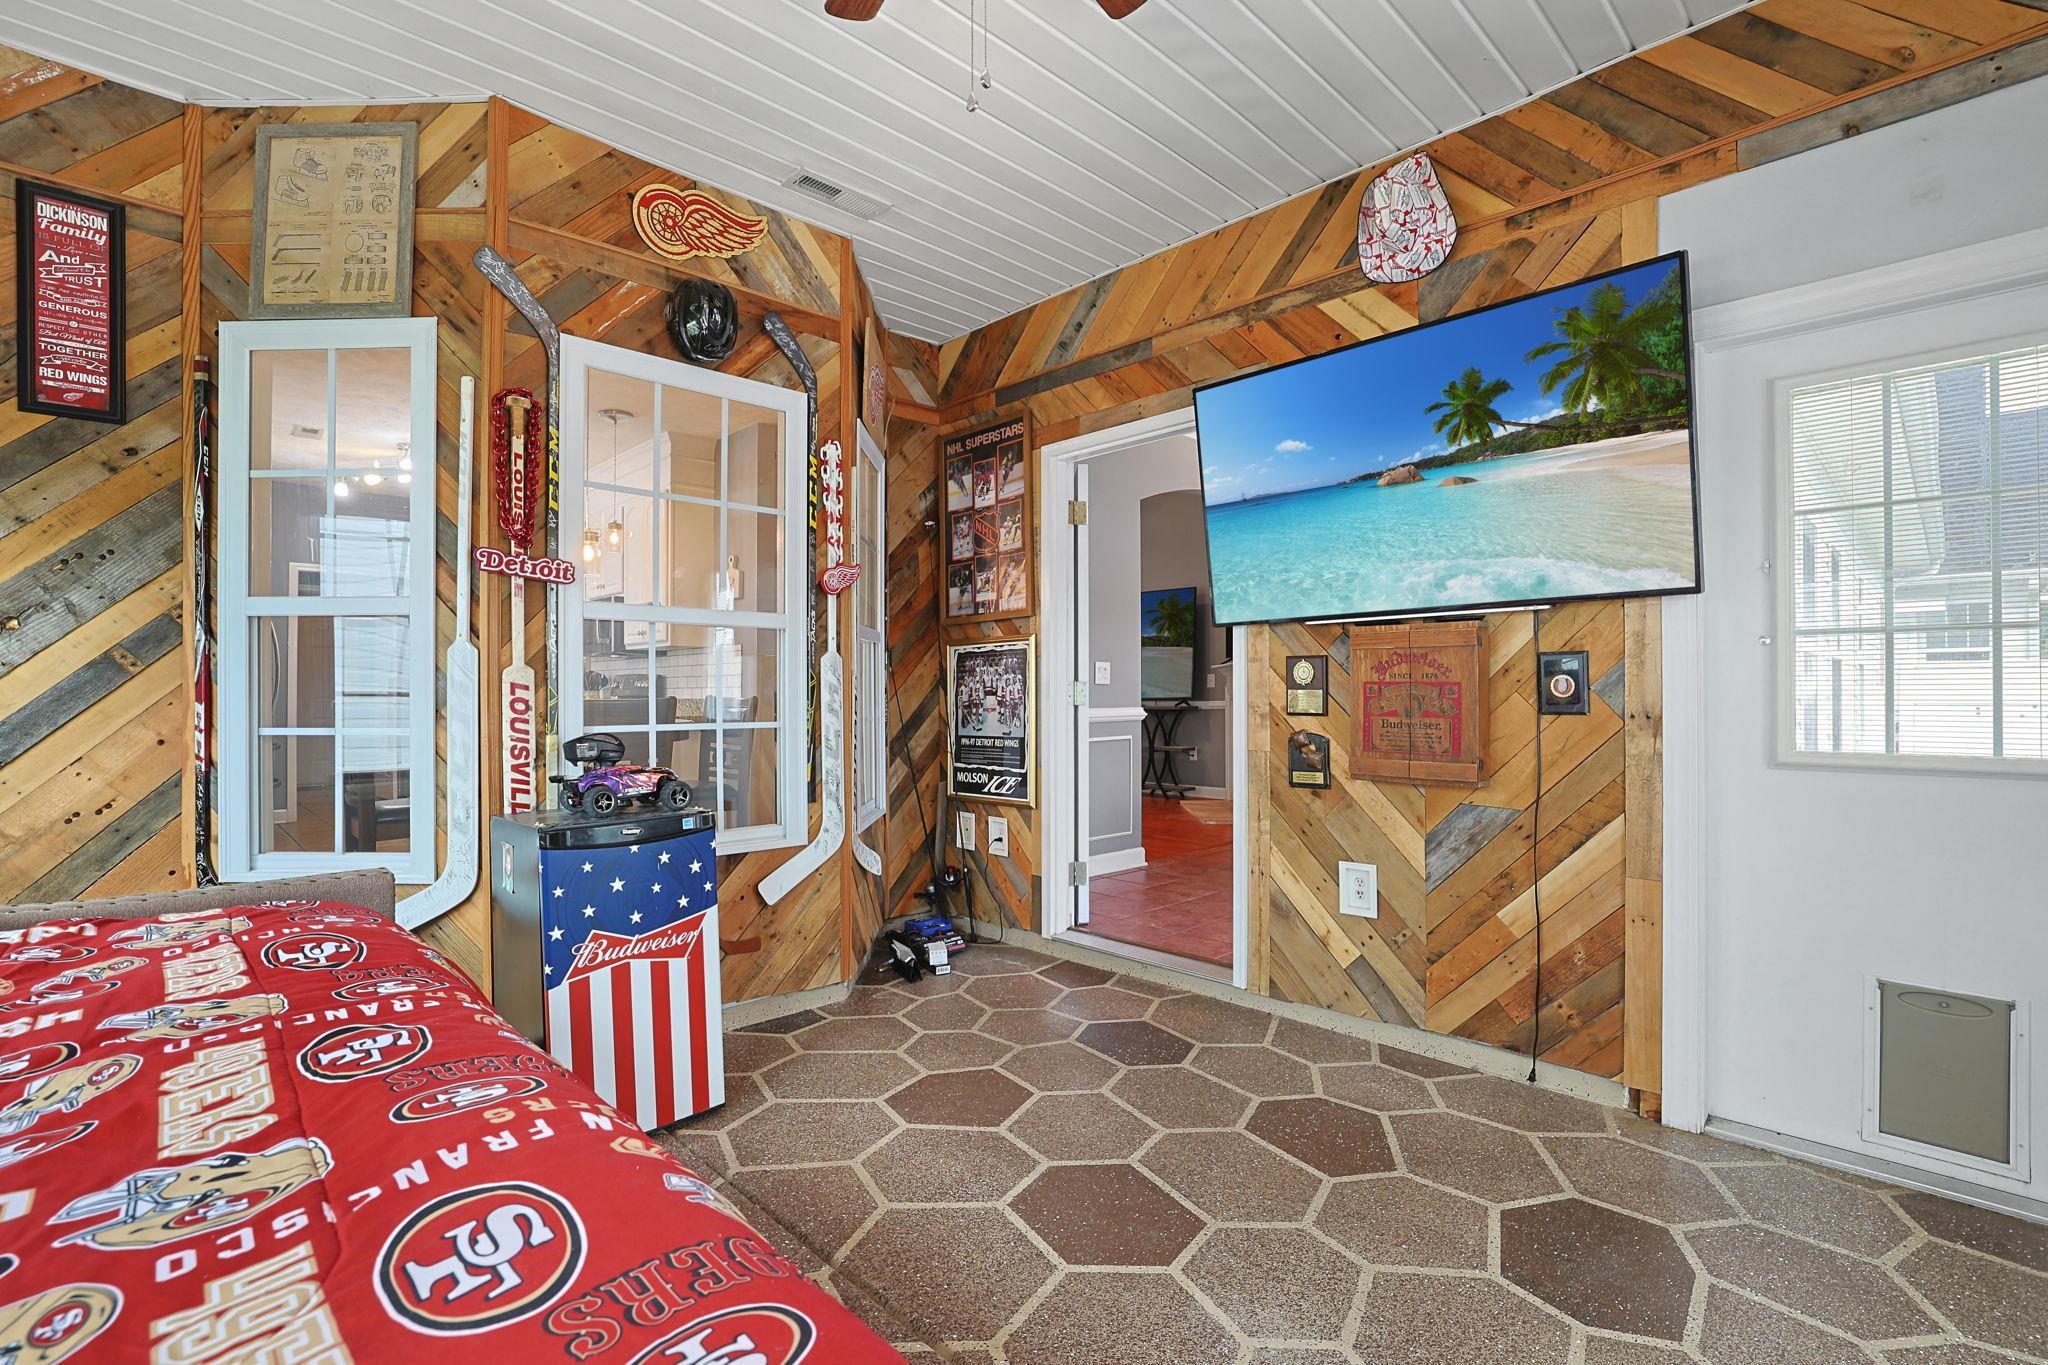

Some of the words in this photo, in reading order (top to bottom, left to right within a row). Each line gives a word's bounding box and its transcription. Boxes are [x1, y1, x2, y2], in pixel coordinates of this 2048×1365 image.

[36, 201, 108, 232] DICKINSON
[38, 217, 107, 246] Family
[38, 231, 49, 240] IS
[54, 235, 86, 248] FULL
[38, 249, 80, 264] And
[63, 275, 108, 288] TRUST
[38, 300, 108, 319] GENEROUS
[38, 322, 65, 331] RESPECT
[82, 330, 108, 339] OTHER
[38, 342, 108, 361] TOGETHER
[38, 366, 64, 380] RED
[66, 370, 108, 386] WINGS
[946, 441, 964, 456] NHL
[965, 422, 1024, 449] SUPERSTARS
[548, 425, 559, 512] CCM
[809, 454, 818, 529] CCM
[975, 519, 995, 541] NHL
[476, 549, 575, 583] Detroit
[509, 682, 531, 814] LOUISVILL
[976, 738, 995, 747] DETROIT
[995, 739, 1004, 747] RED
[1004, 739, 1019, 747] WINGS
[956, 771, 988, 784] MOLSON
[982, 775, 1022, 794] ICE
[571, 928, 702, 968] Budweiser
